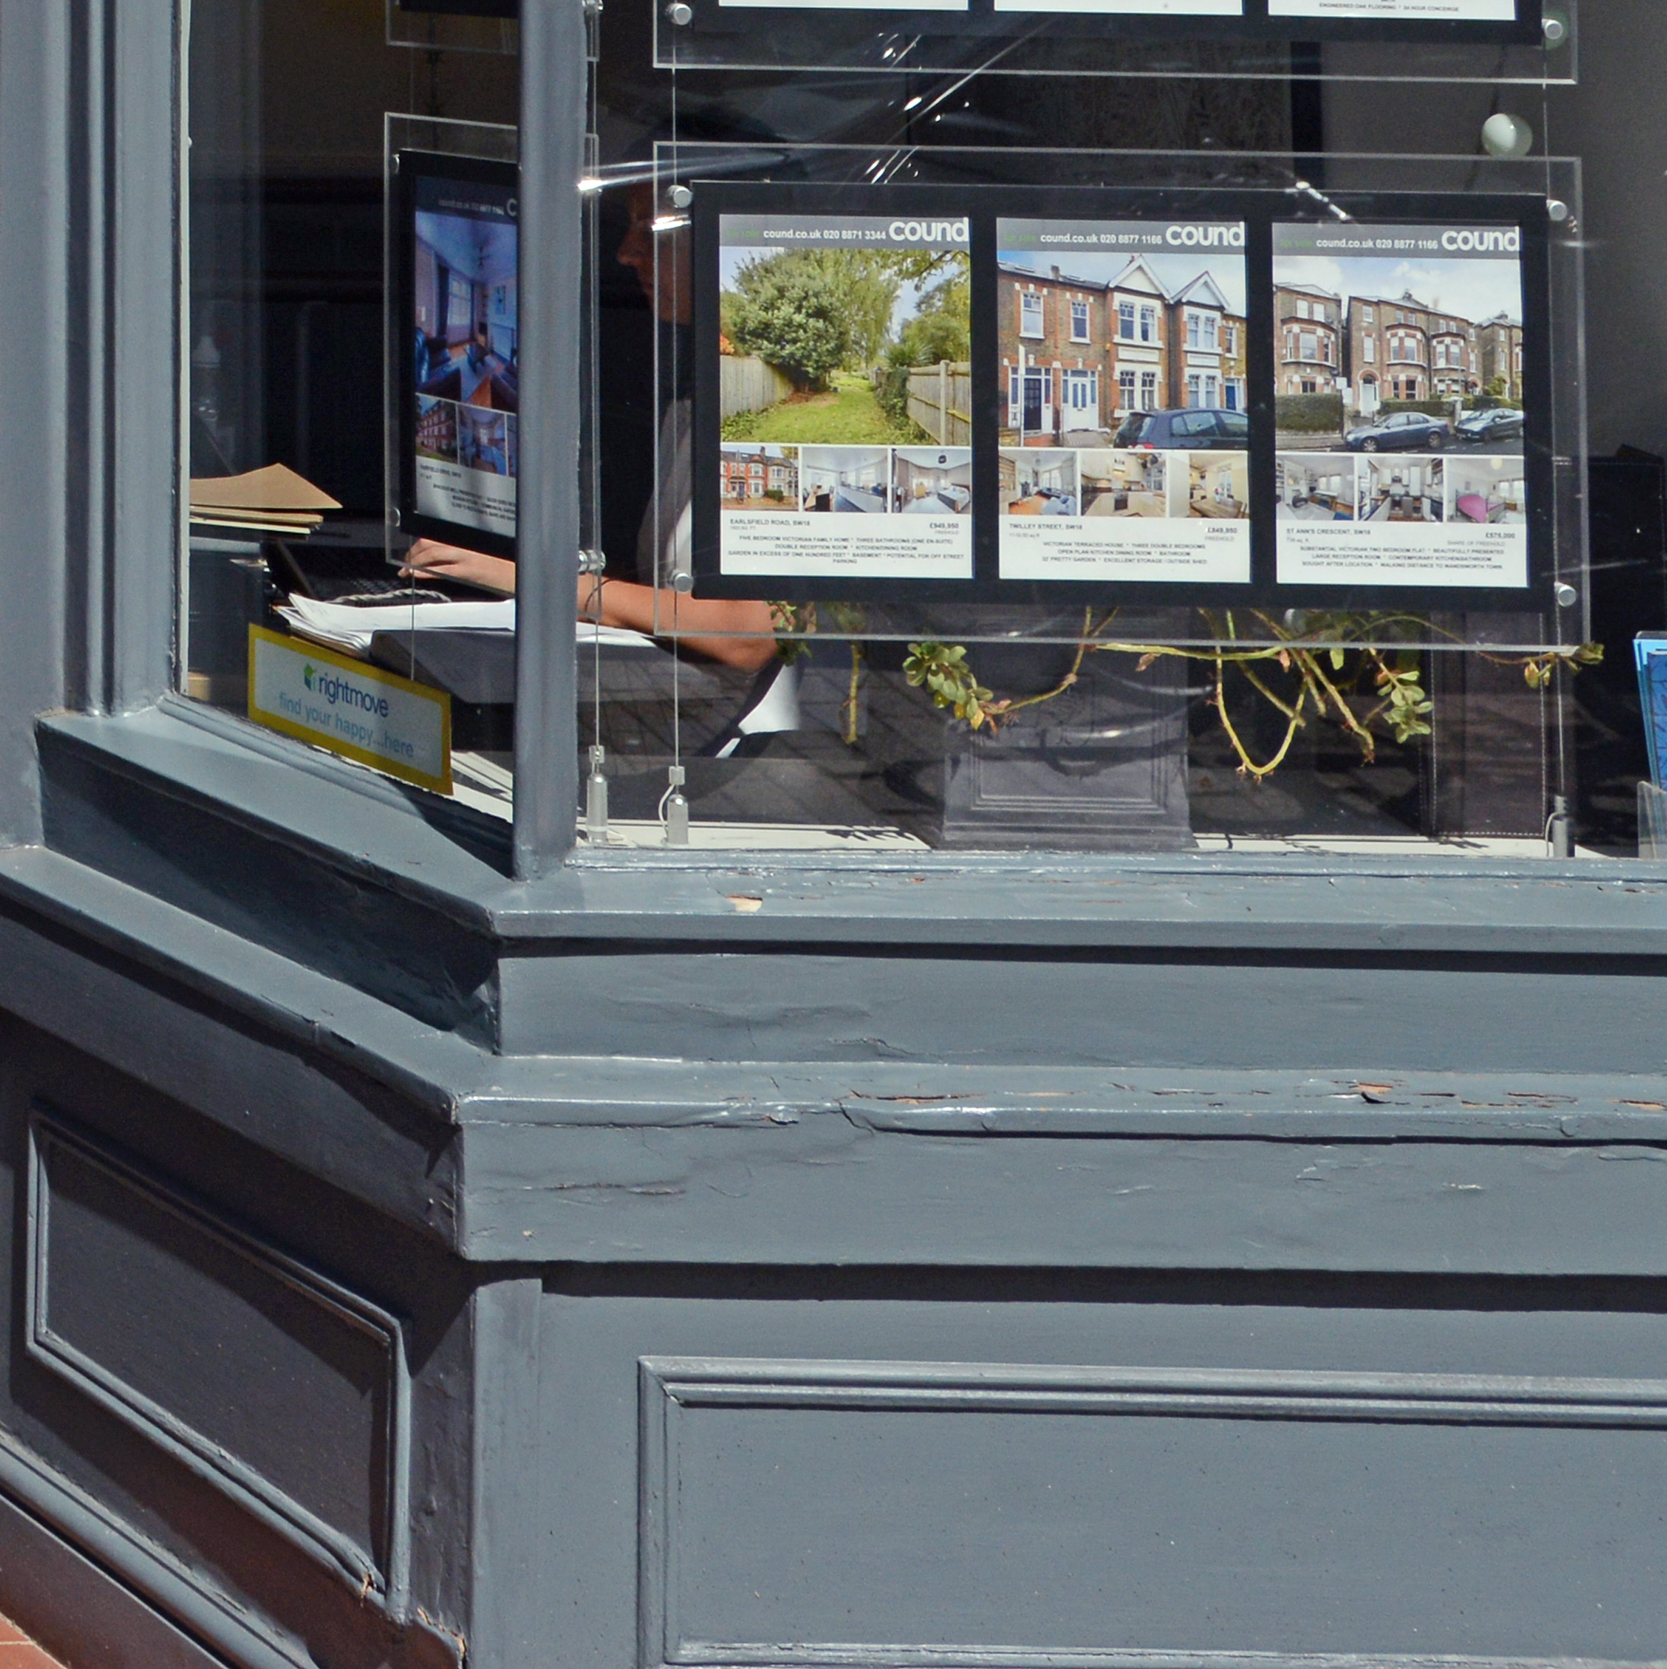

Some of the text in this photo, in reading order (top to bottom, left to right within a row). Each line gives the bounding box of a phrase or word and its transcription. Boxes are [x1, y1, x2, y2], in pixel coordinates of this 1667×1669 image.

[764, 229, 822, 239] cound.co.uk
[823, 231, 839, 239] 020
[842, 231, 862, 239] 8871
[865, 231, 886, 240] 3344
[889, 217, 969, 242] cound
[1041, 234, 1099, 244] cound.co.uk
[1100, 235, 1117, 243] 020
[1119, 235, 1139, 244] 8877
[1141, 236, 1162, 244] 1166
[1166, 222, 1245, 246] cound
[1442, 226, 1520, 251] cound
[1317, 239, 1374, 249] cound.co.uk
[1376, 240, 1392, 249] 020
[1394, 240, 1415, 249] 8877
[1418, 241, 1438, 250] 1166
[319, 673, 389, 718] rightmove
[279, 692, 301, 716] find
[305, 705, 331, 726] your
